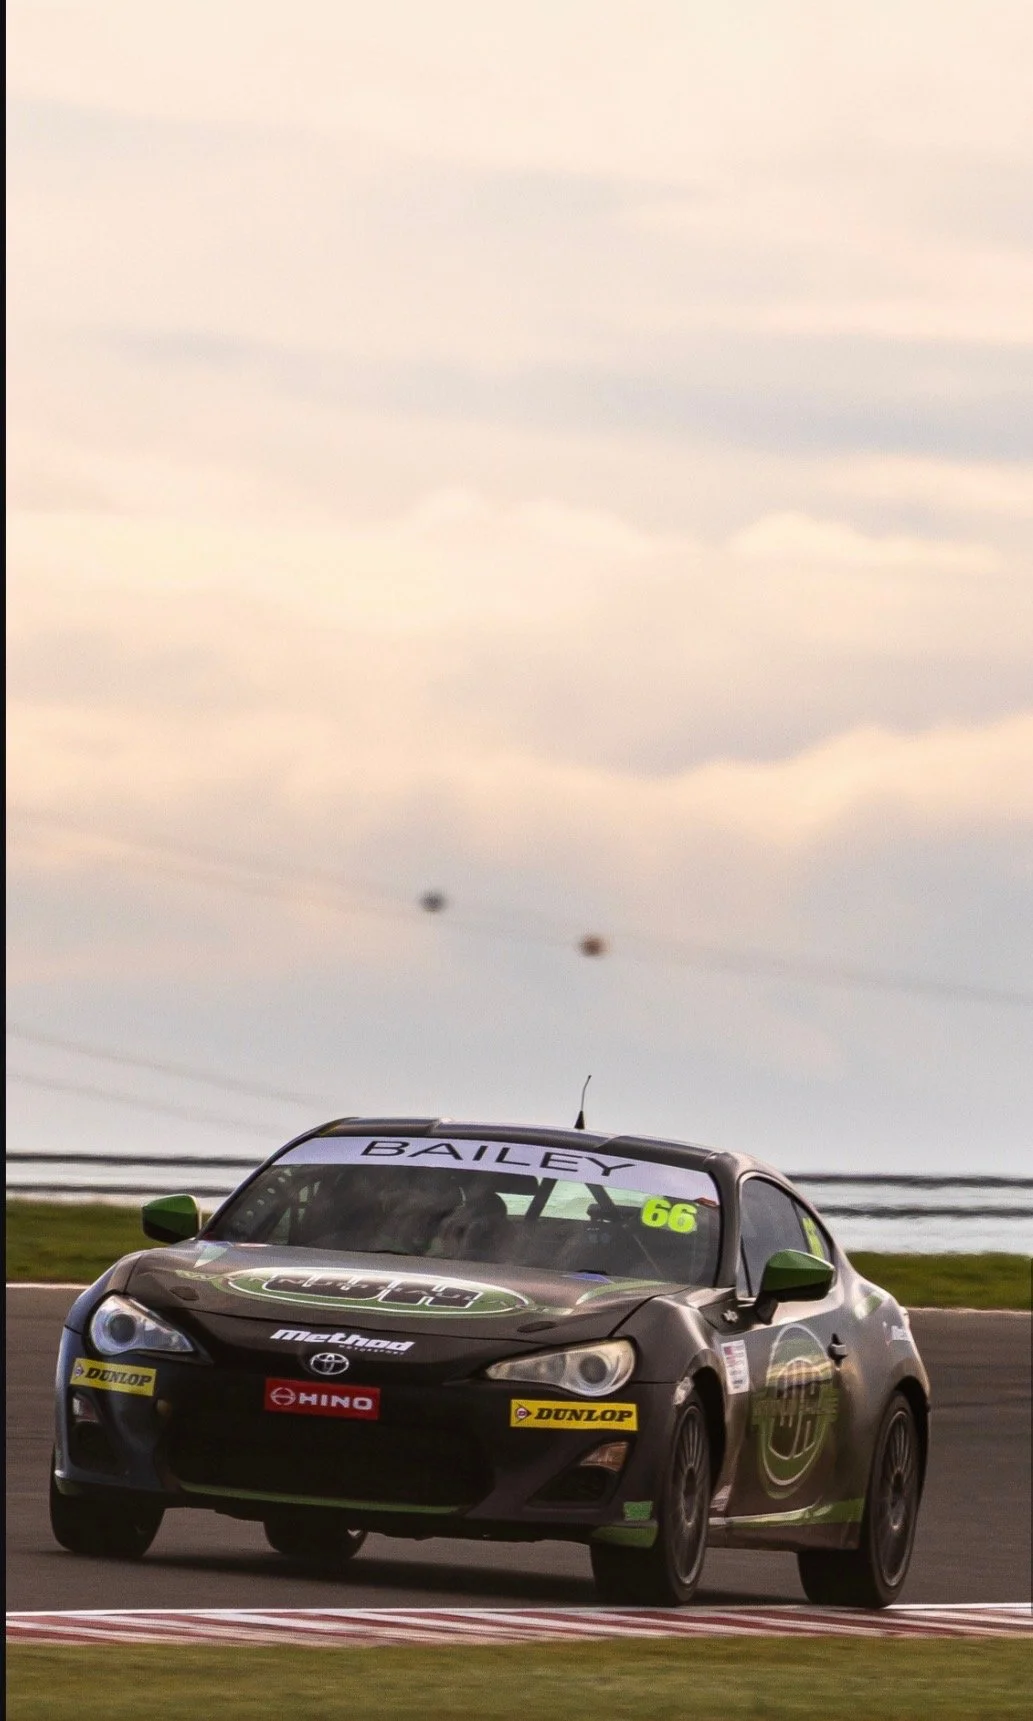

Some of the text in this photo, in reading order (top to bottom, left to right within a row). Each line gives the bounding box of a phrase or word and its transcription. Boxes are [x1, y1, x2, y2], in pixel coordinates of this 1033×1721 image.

[361, 1140, 635, 1177] BAILEY
[641, 1196, 698, 1234] 66
[85, 1368, 152, 1386] DUNLOP
[298, 1392, 373, 1410] HINO
[534, 1406, 633, 1423] DUNLOP
